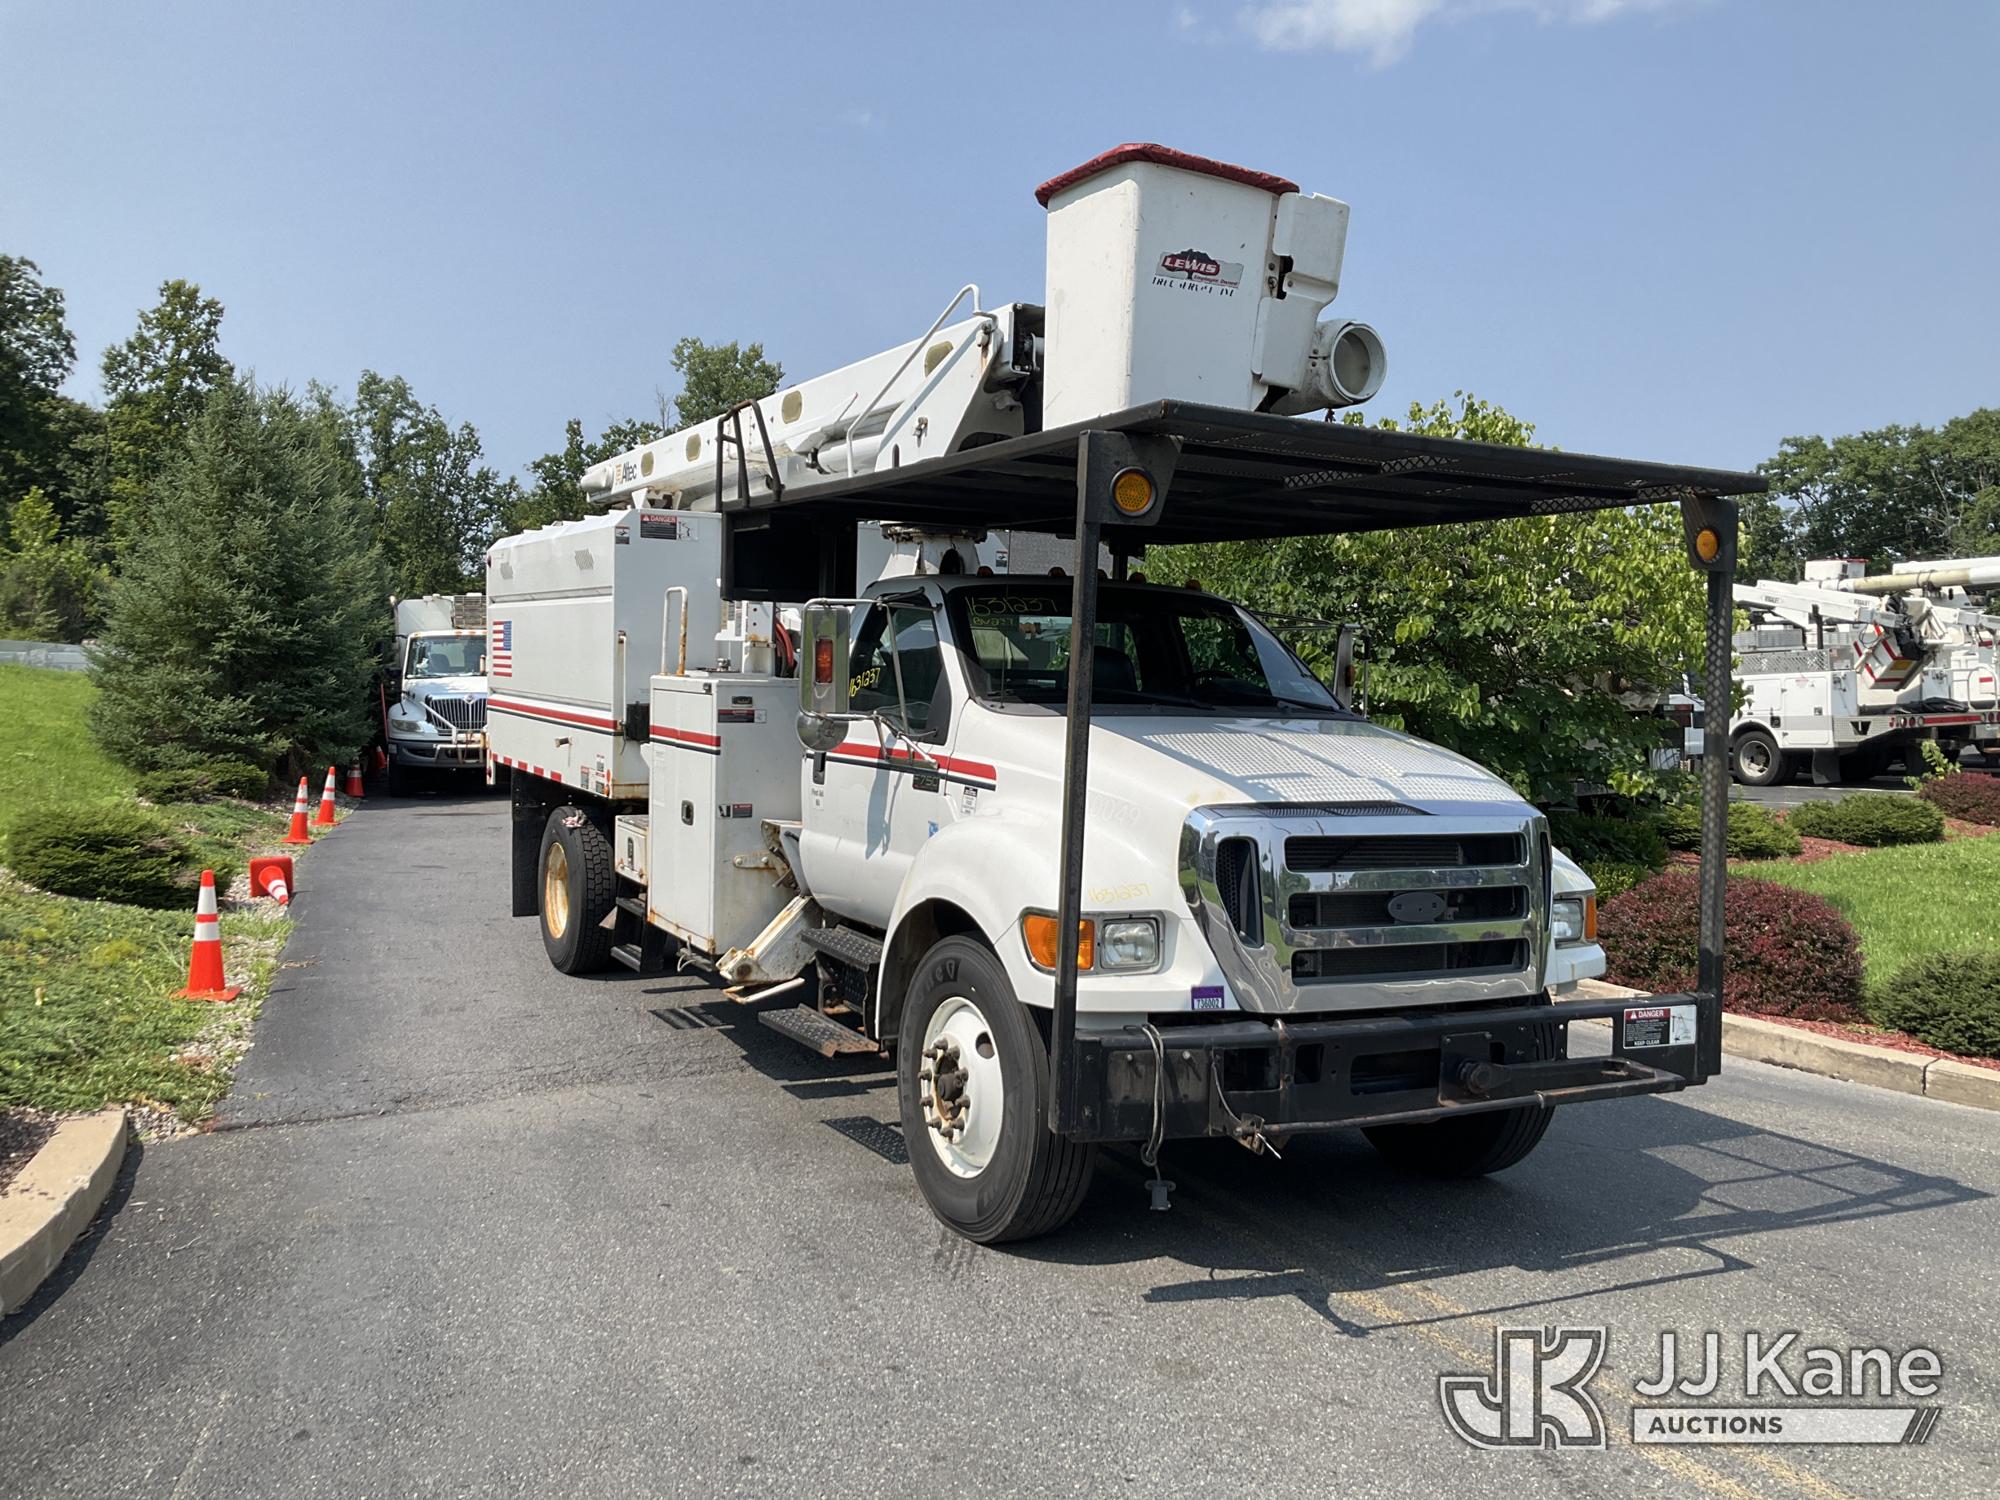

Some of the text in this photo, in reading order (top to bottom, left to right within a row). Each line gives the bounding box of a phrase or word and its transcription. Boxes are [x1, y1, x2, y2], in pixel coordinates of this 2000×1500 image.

[1164, 257, 1217, 273] LEWIS
[622, 461, 637, 482] Altec
[650, 515, 676, 523] DANGER
[965, 596, 1058, 617] 1631237
[1638, 1009, 1664, 1018] DANGER
